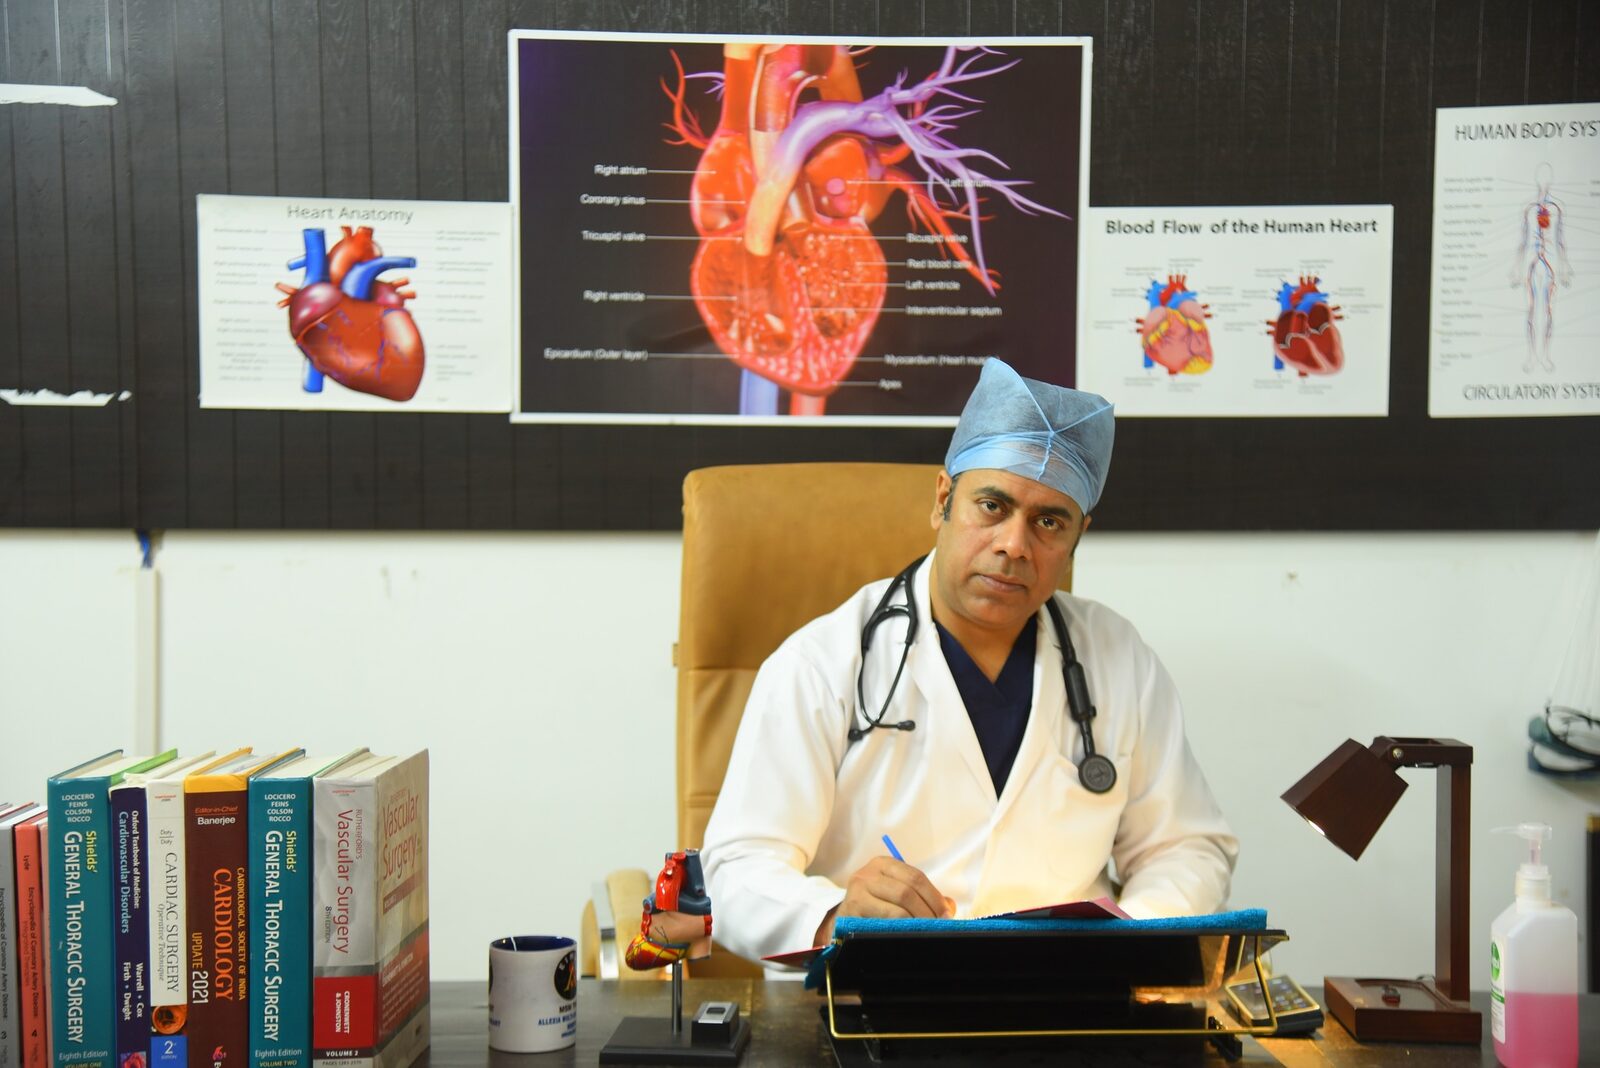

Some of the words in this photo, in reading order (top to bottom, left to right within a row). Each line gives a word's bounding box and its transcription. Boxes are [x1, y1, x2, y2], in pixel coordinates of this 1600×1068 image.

[1455, 122, 1517, 141] HUMAN
[1520, 121, 1566, 139] BODY
[594, 164, 619, 177] Right
[619, 165, 648, 175] atrium
[287, 205, 333, 220] Heart
[340, 206, 413, 225] Anatomy
[580, 193, 620, 207] Coronary
[621, 195, 646, 206] sinus
[1106, 220, 1155, 234] Blood
[1163, 220, 1202, 234] Flow
[1211, 219, 1229, 234] of
[1232, 219, 1259, 234] the
[1264, 220, 1325, 233] Human
[1330, 219, 1378, 233] Heart
[583, 290, 608, 303] Right
[608, 291, 646, 302] ventricle
[905, 280, 923, 290] Left
[924, 280, 960, 291] ventricle
[1463, 383, 1558, 401] CIRCULATORY
[62, 793, 95, 801] LOCICERO
[65, 808, 92, 816] COLSON
[195, 806, 238, 814] Editor-in-Chief
[264, 793, 296, 801] LOCICERO
[131, 810, 140, 835] Oxford
[197, 816, 236, 826] Banerjee
[382, 788, 419, 840] Vascular
[86, 830, 98, 873] Shields'
[119, 811, 131, 884] Cardiovascular
[132, 836, 141, 866] Textbook
[286, 830, 297, 873] Shields'
[337, 809, 353, 879] Vascular
[383, 833, 417, 880] Surgery
[64, 831, 83, 898] GENERAL
[133, 867, 141, 875] of
[265, 830, 283, 897] GENERAL
[165, 852, 178, 921] CARDIAC
[237, 867, 246, 928] CARDIOLOGICAL
[120, 886, 132, 934] Disorders
[333, 886, 353, 954] Surgery
[66, 900, 85, 976] THORACIC
[213, 868, 234, 1000] CARDIOLOGY
[238, 931, 247, 962] SOCIETY
[264, 900, 283, 972] THORACIC
[166, 924, 180, 993] SURGERY
[192, 932, 203, 968] UPDATE
[123, 962, 132, 981] Firth
[136, 962, 144, 992] Warrell
[238, 964, 247, 975] OF
[192, 970, 209, 1004] 2021
[239, 977, 248, 1001] INDIA
[66, 976, 86, 1044] SURGERY
[122, 992, 132, 1021] Dwight
[136, 1003, 145, 1018] Cox
[264, 975, 283, 1041] SURGERY
[59, 1052, 82, 1062] Eighth
[83, 1050, 108, 1060] Edition
[255, 1049, 277, 1058] Eighth
[278, 1048, 302, 1057] Edition
